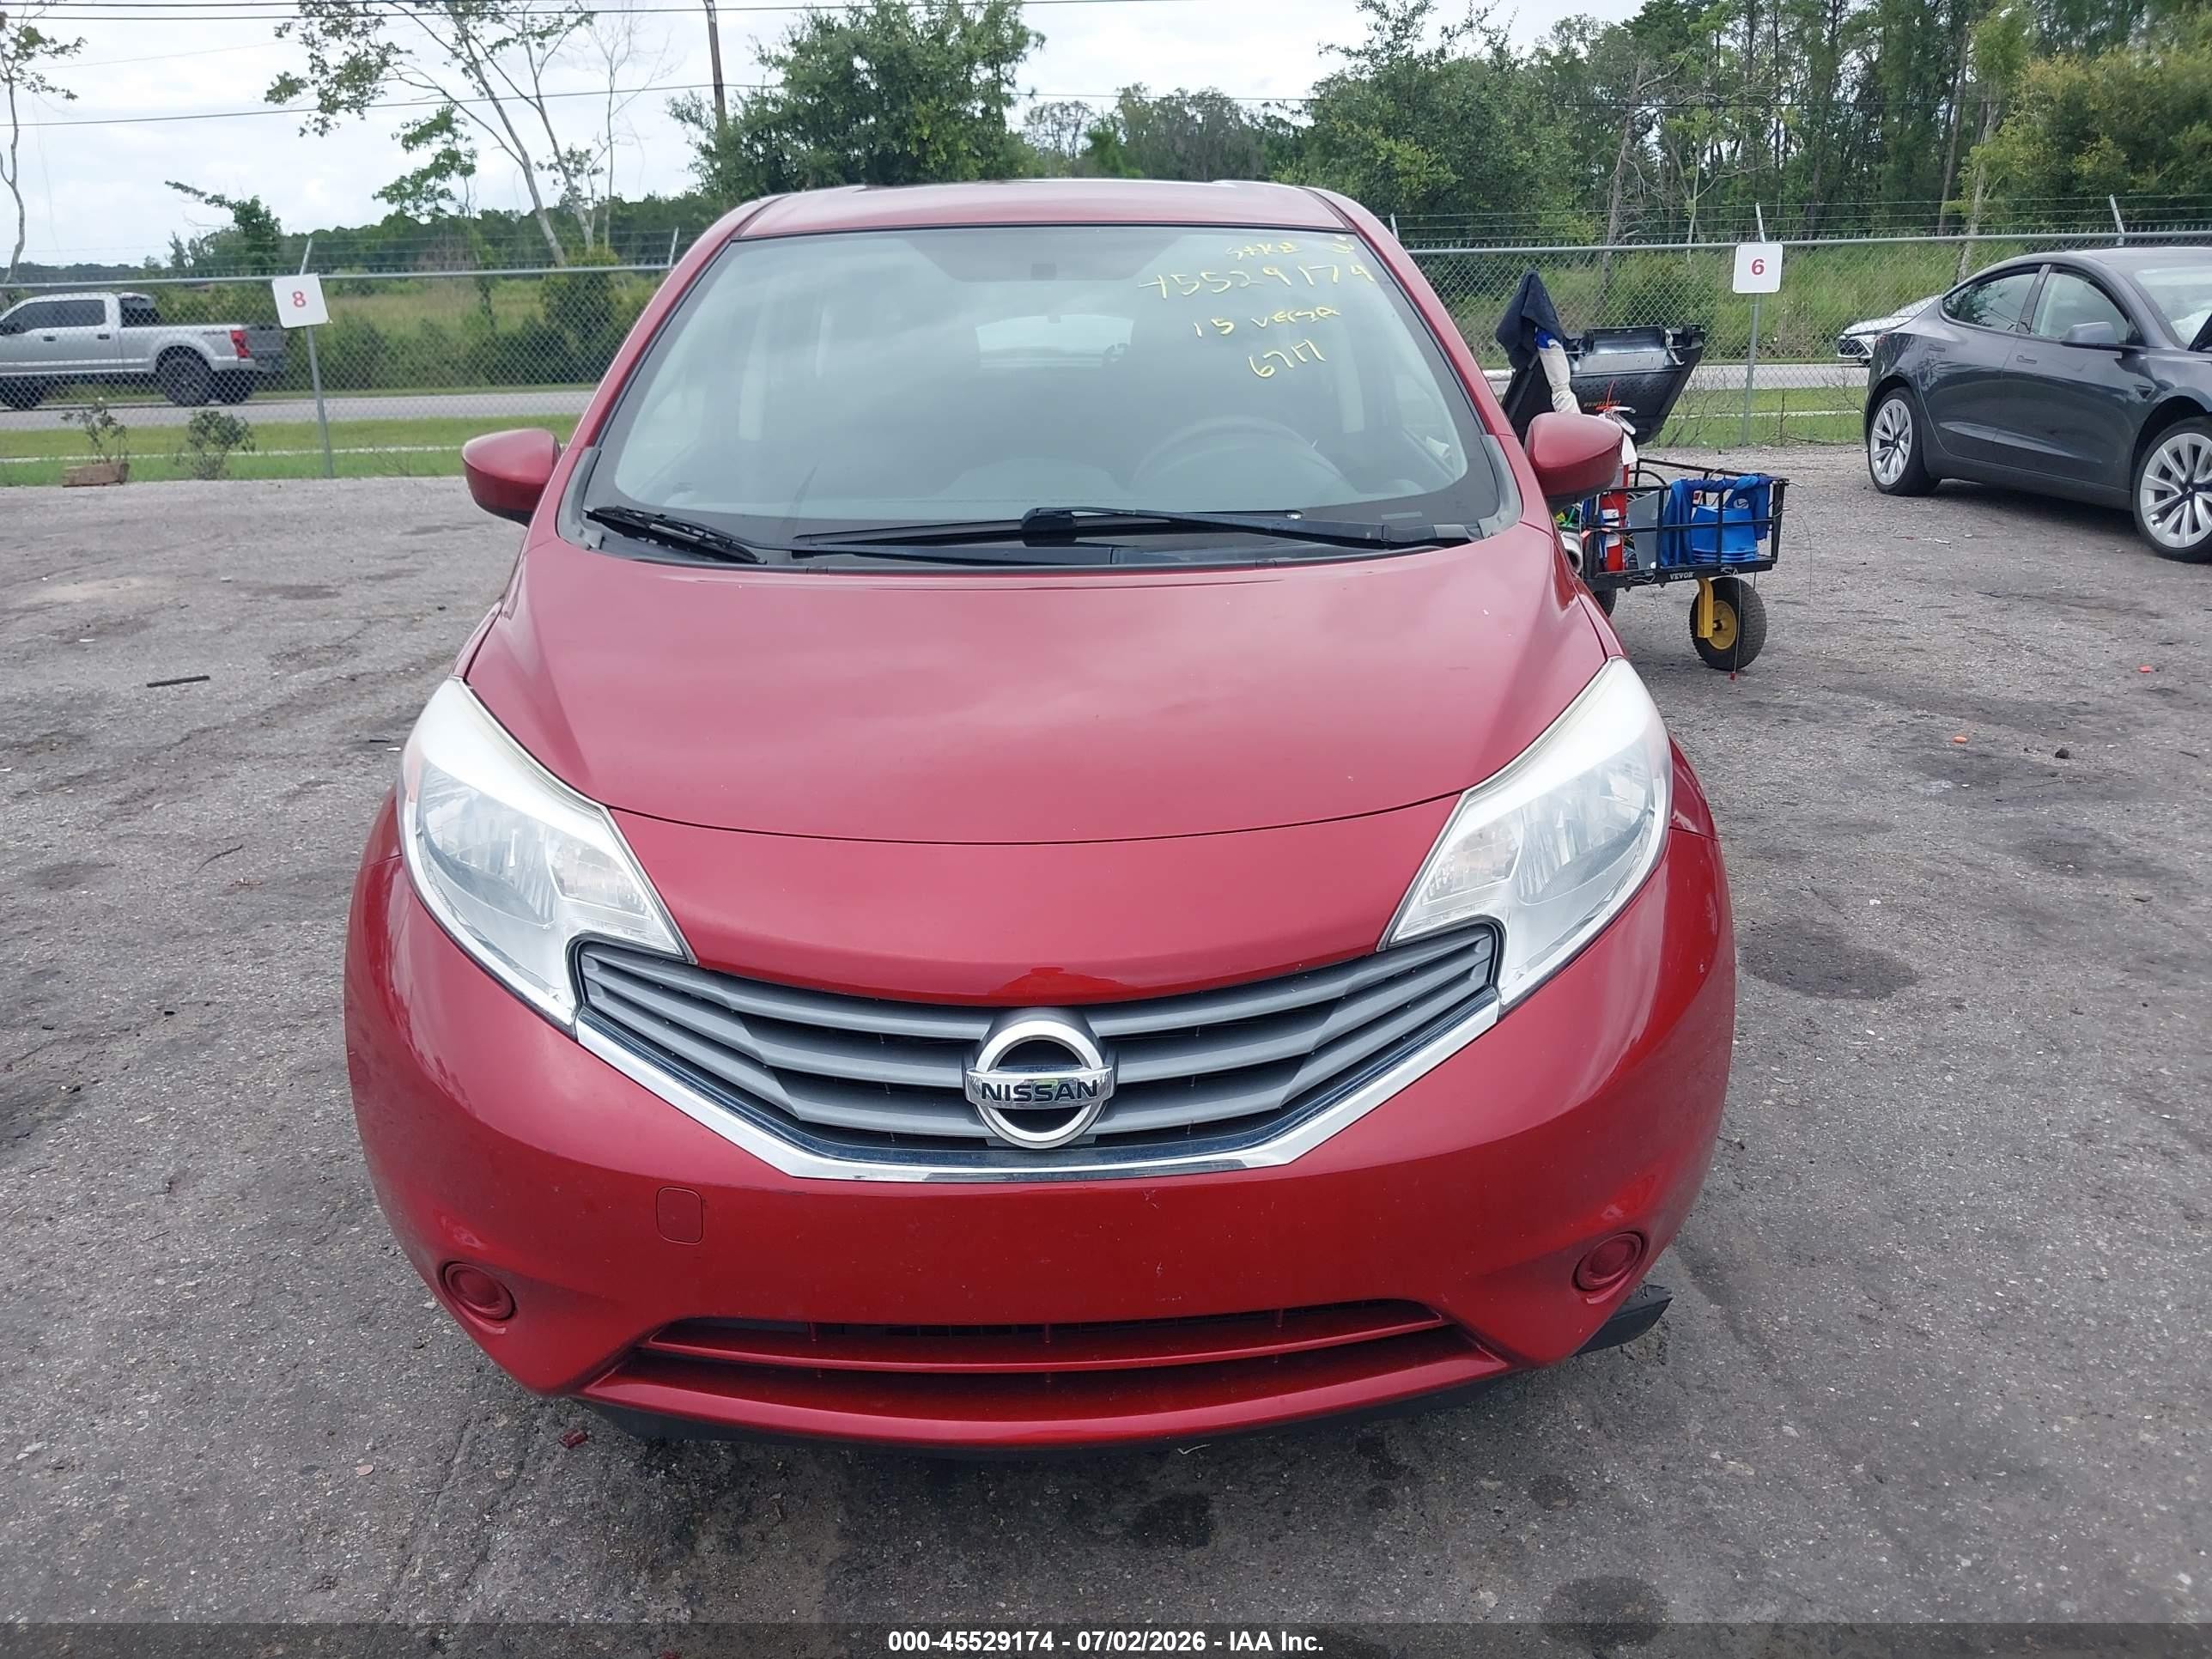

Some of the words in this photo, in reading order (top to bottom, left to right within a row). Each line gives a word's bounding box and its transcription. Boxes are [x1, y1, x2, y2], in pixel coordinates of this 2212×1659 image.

[1752, 258, 1765, 276] 6
[292, 290, 307, 308] 8
[1669, 571, 1695, 580] VEVOR
[981, 1079, 1097, 1102] NISSAN
